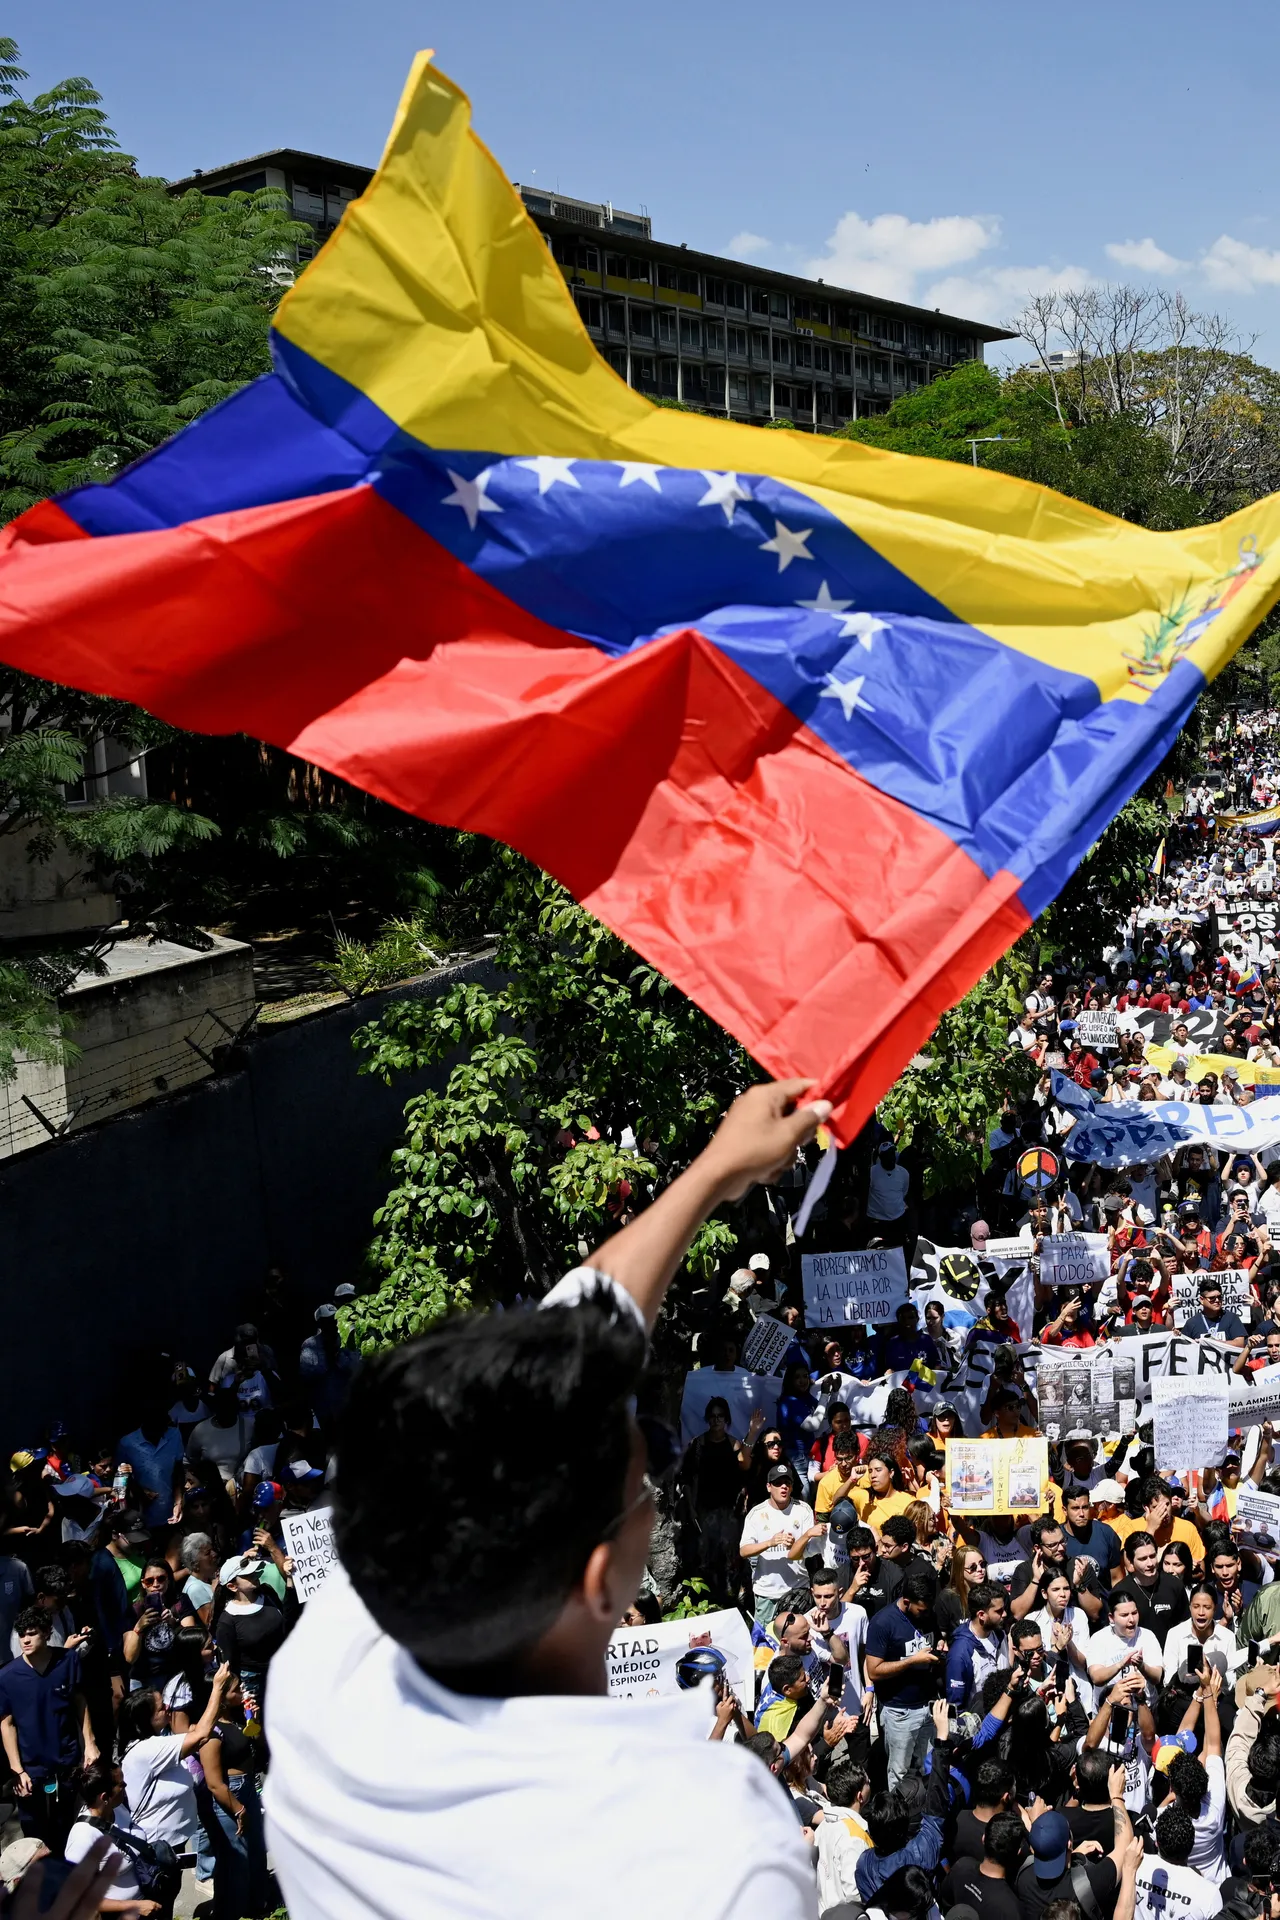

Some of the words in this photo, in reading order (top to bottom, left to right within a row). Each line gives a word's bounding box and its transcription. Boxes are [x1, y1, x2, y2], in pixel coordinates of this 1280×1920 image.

[1218, 914, 1276, 930] LOS
[1061, 1246, 1089, 1260] PARA
[813, 1253, 887, 1277] REPRESENTAMOS
[1049, 1262, 1094, 1282] TODOS
[817, 1284, 830, 1300] LA
[835, 1280, 870, 1299] LUCHA
[872, 1277, 892, 1294] POR
[1177, 1288, 1191, 1297] NO
[820, 1306, 834, 1323] LA
[843, 1300, 891, 1320] LIBERTAD
[1179, 1299, 1195, 1307] ON
[763, 1330, 784, 1359] PRESOS
[763, 1333, 790, 1372] OLÍTICOS
[289, 1523, 304, 1537] En
[292, 1540, 305, 1555] la
[308, 1532, 337, 1552] liber
[605, 1638, 659, 1660] RTAD
[611, 1658, 661, 1675] MÉDICO
[610, 1672, 657, 1687] ESPINOZA
[1134, 1878, 1192, 1906] JOROPO
